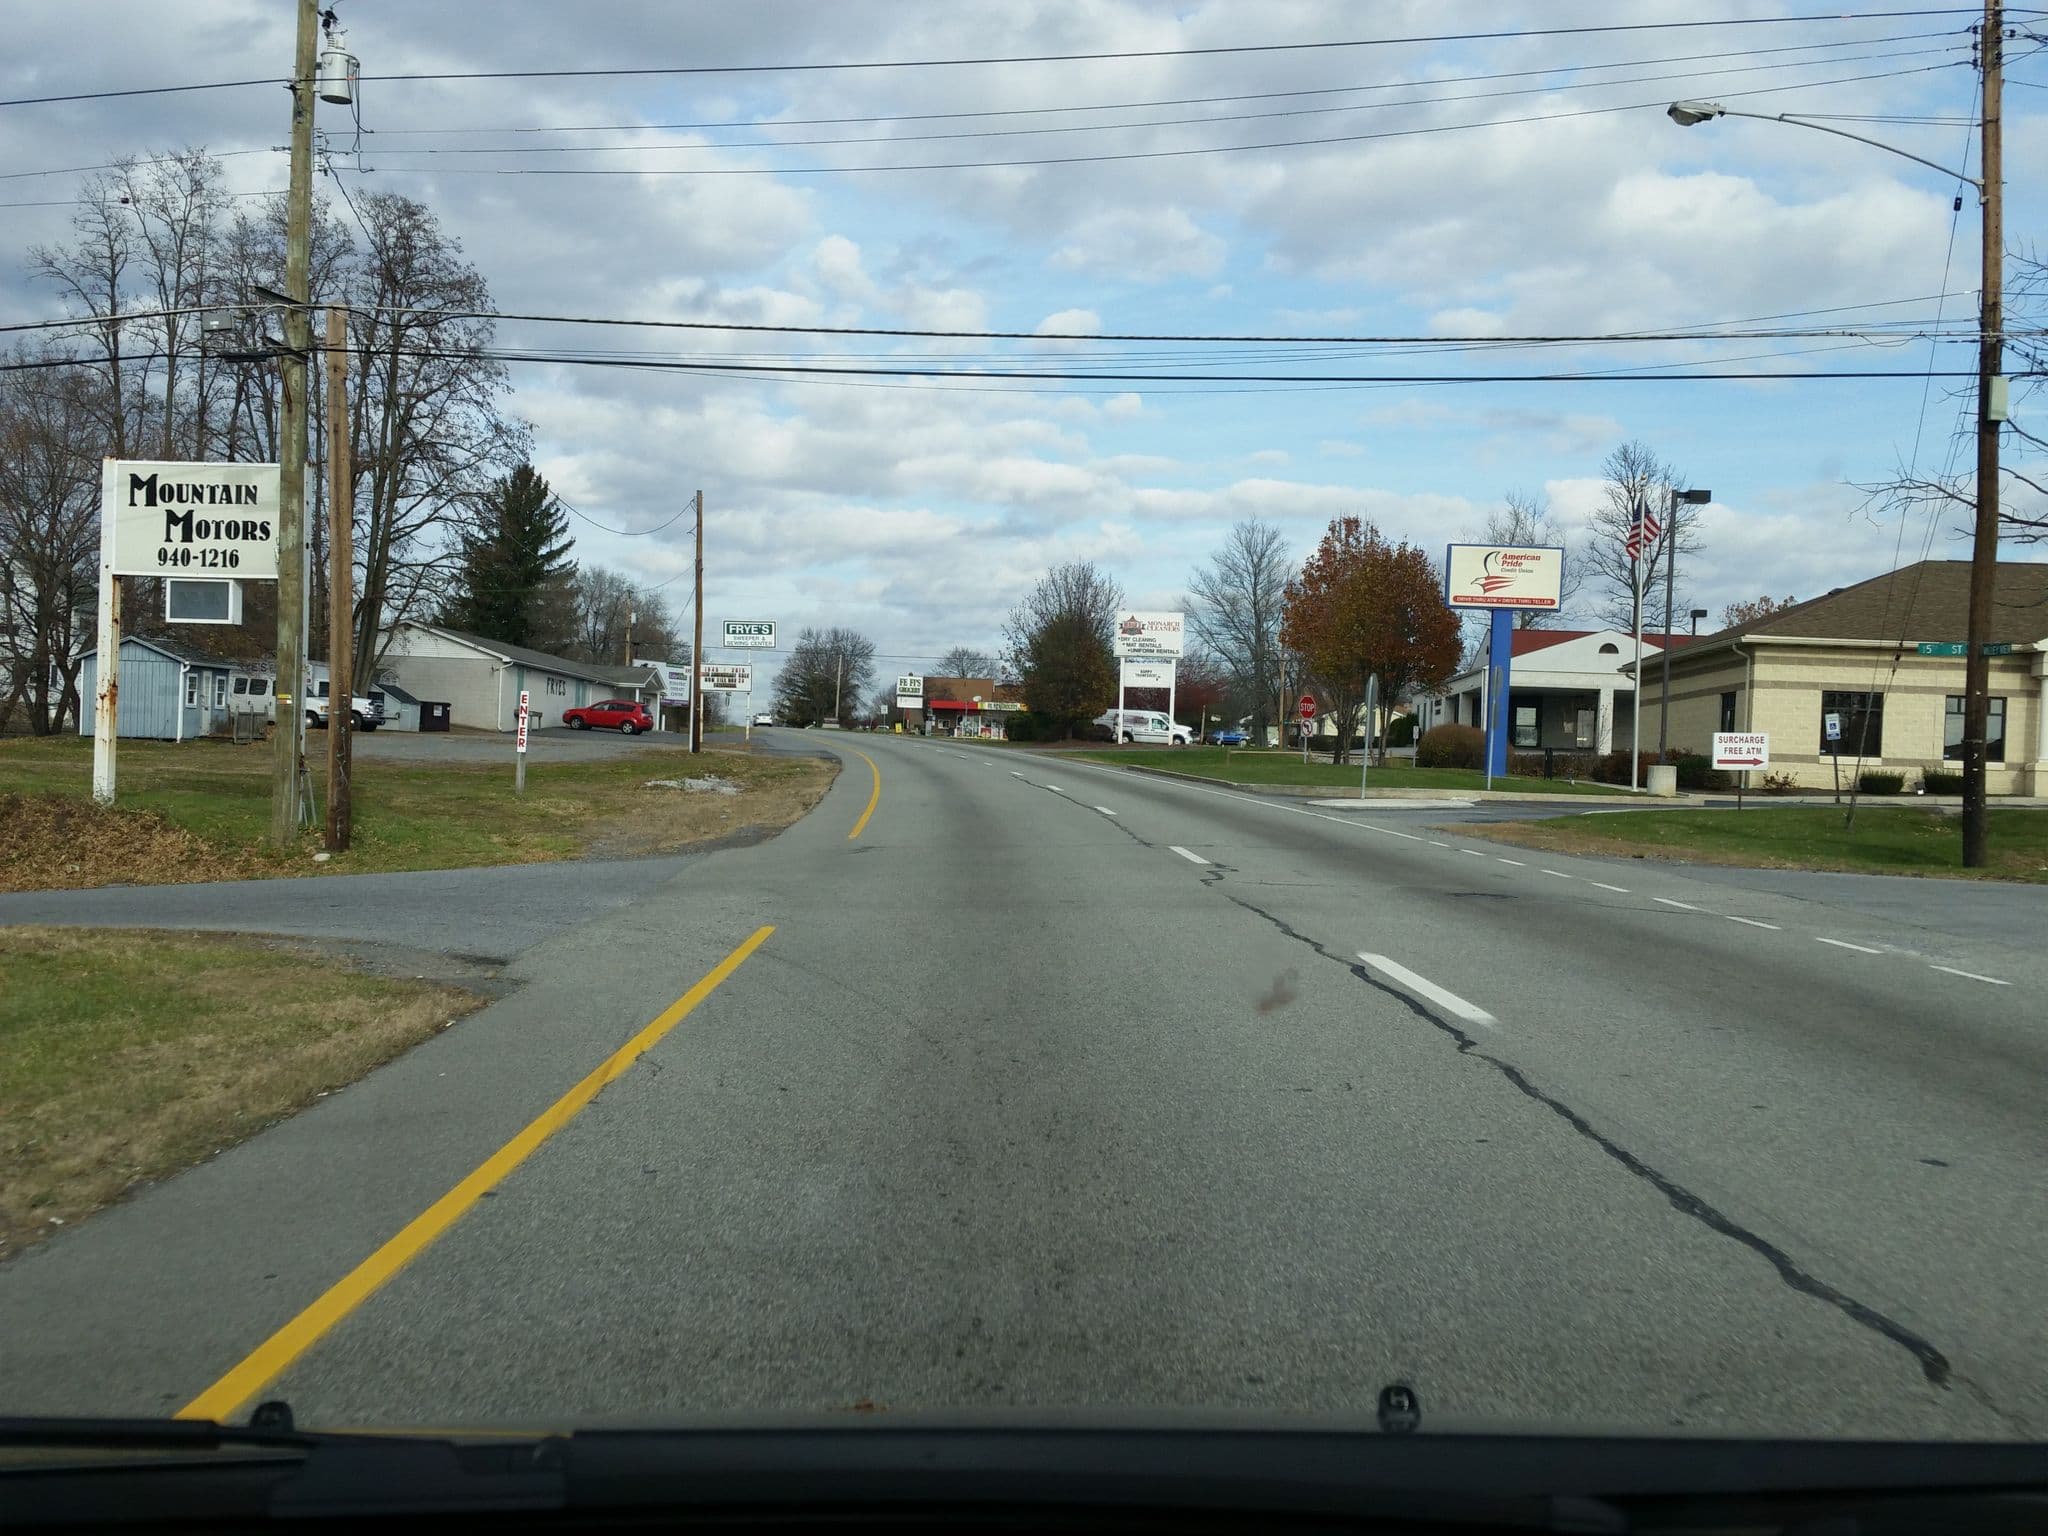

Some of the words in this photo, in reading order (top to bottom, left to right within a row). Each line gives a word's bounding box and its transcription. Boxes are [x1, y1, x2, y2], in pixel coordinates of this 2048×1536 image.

[129, 473, 258, 507] MOUNTAIN
[164, 509, 271, 543] MOTORS
[157, 547, 240, 568] 940-1216
[1501, 553, 1541, 561] American
[729, 624, 770, 634] FRYE'S
[1951, 645, 1962, 655] ST
[547, 677, 567, 696] FRYES
[900, 679, 908, 687] FE
[1301, 703, 1315, 712] STOP
[518, 694, 528, 747] ENTER
[1718, 735, 1765, 744] SURCHARGE
[1724, 746, 1744, 755] FREE
[1746, 747, 1762, 755] ATM
